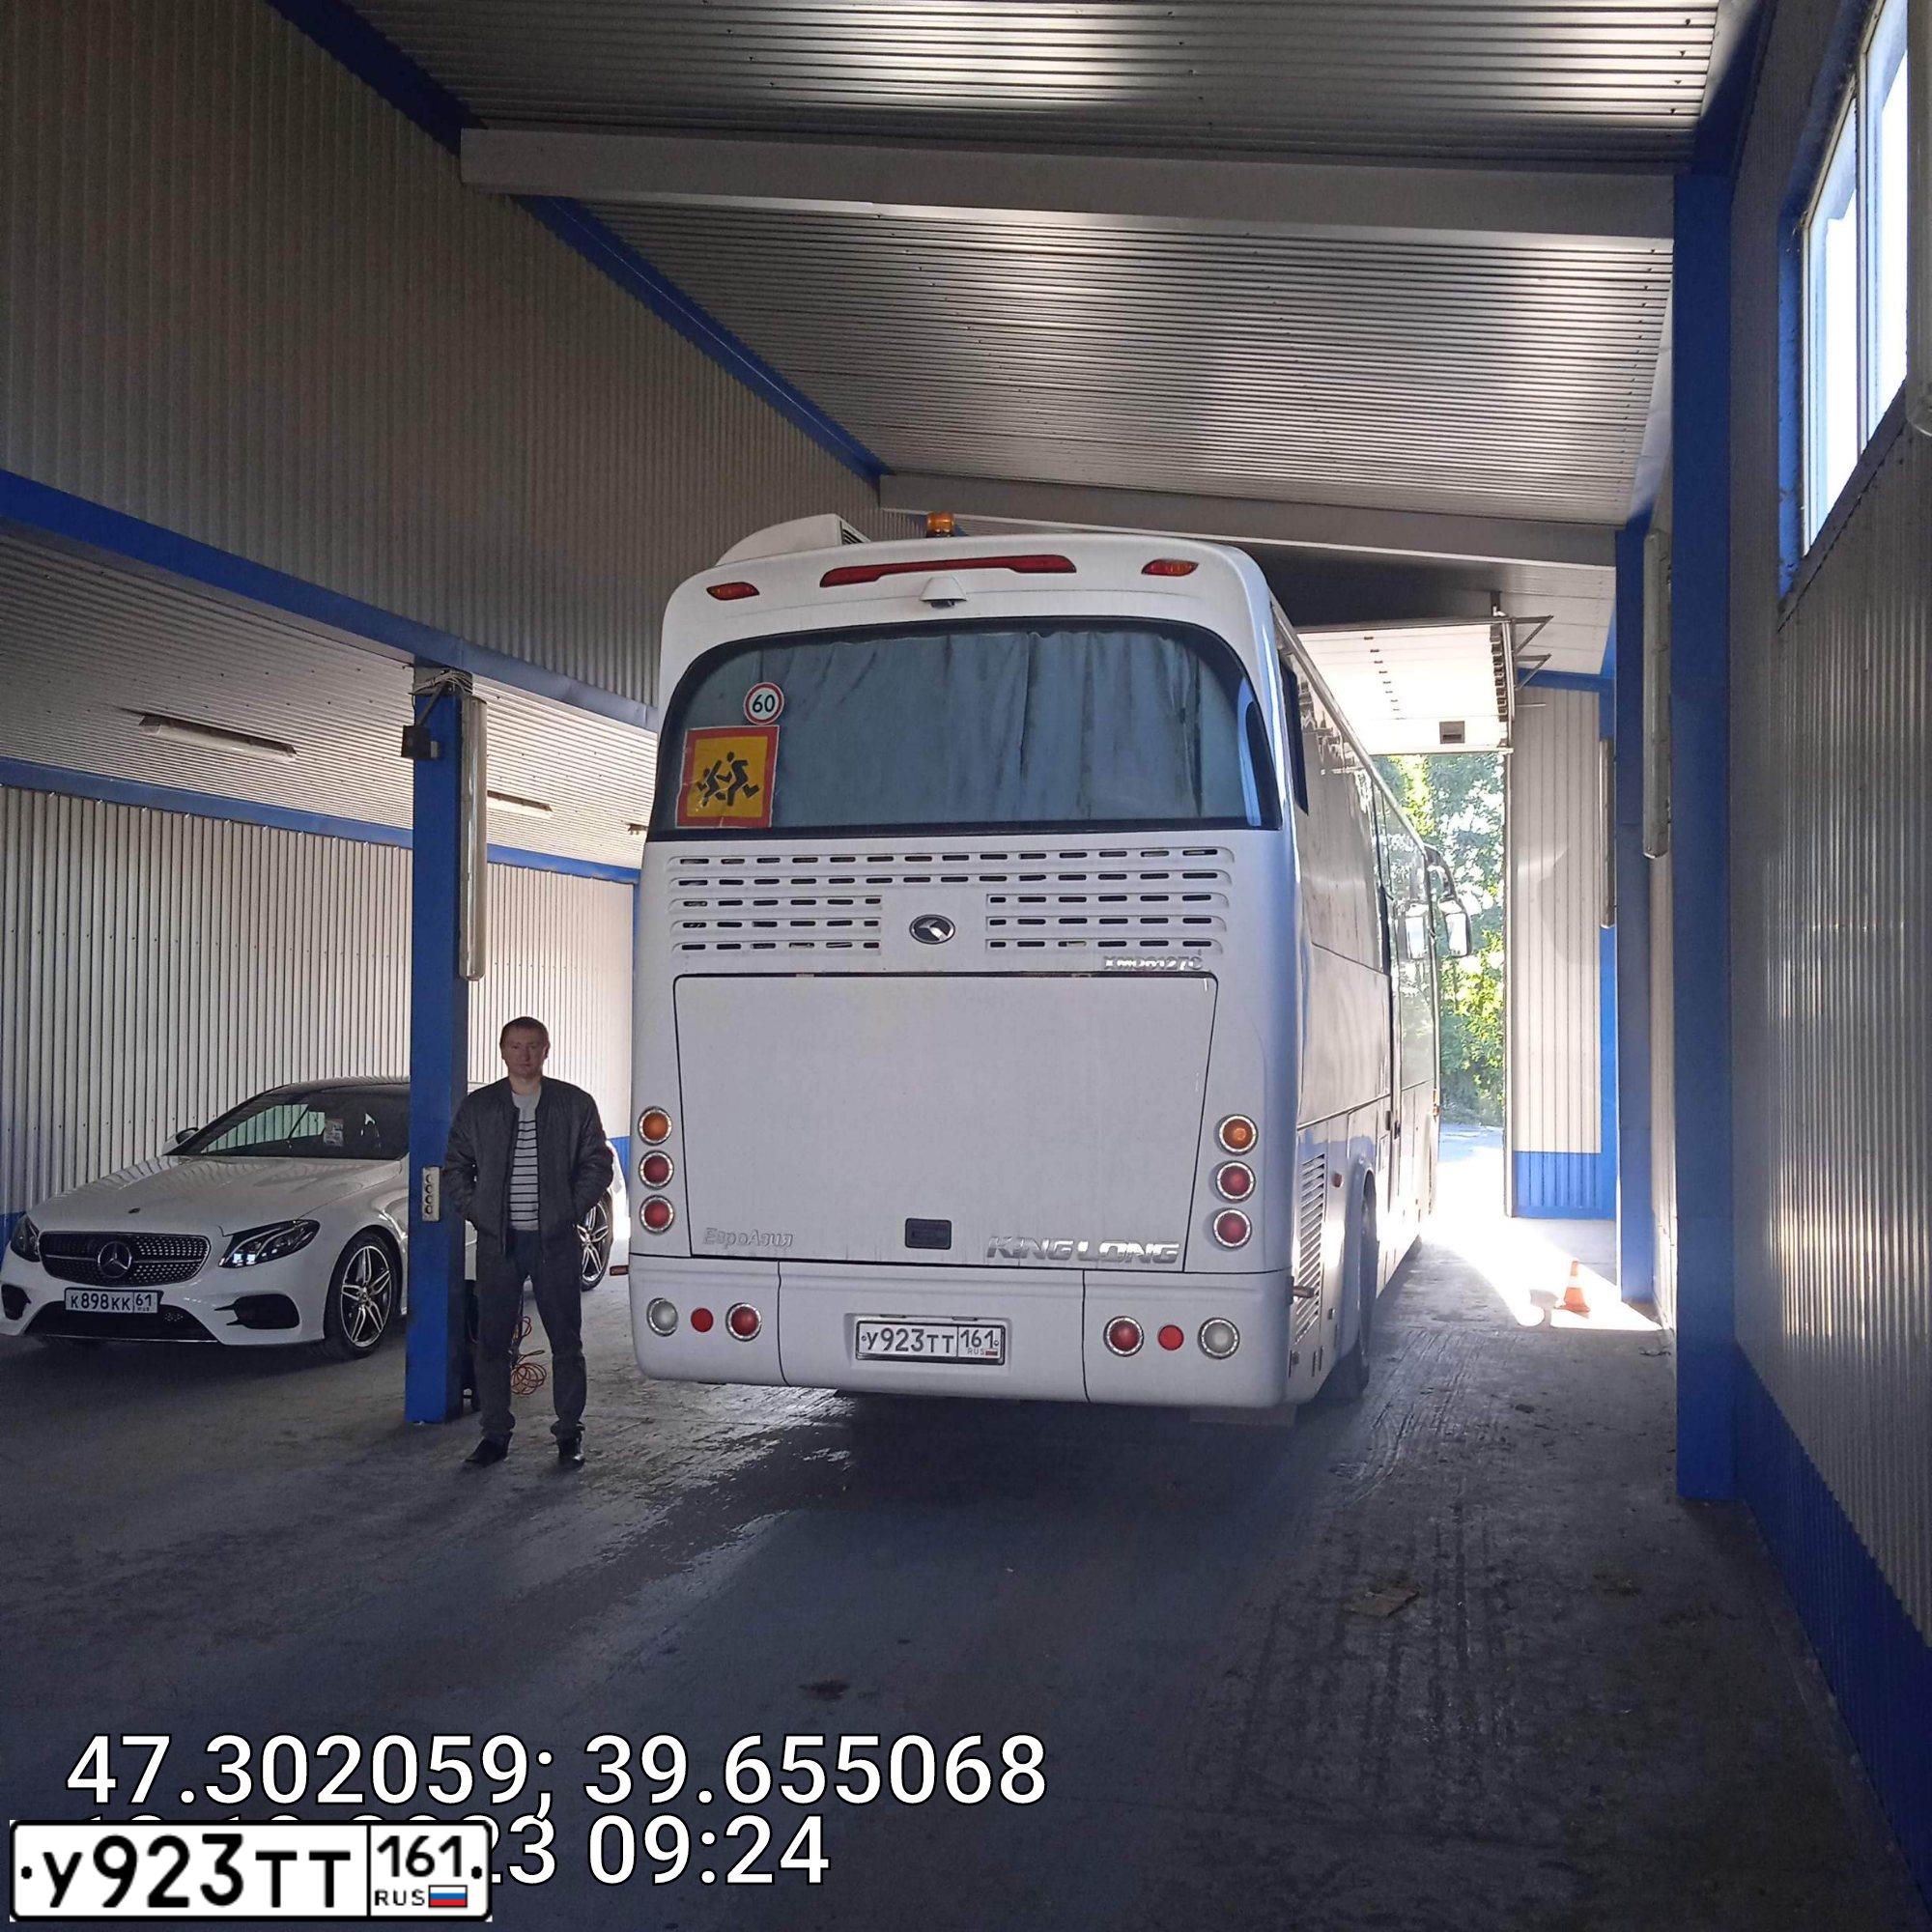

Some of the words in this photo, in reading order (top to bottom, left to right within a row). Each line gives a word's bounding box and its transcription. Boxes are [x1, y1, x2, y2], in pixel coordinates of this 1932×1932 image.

[752, 694, 776, 713] 60
[703, 1227, 794, 1250] ЕвроАзия
[986, 1236, 1074, 1261] KING
[1076, 1239, 1180, 1264] LONG
[71, 1293, 131, 1311] К898КК
[135, 1293, 152, 1307] 61
[867, 1326, 954, 1353] У923ТТ
[960, 1328, 994, 1349] 161
